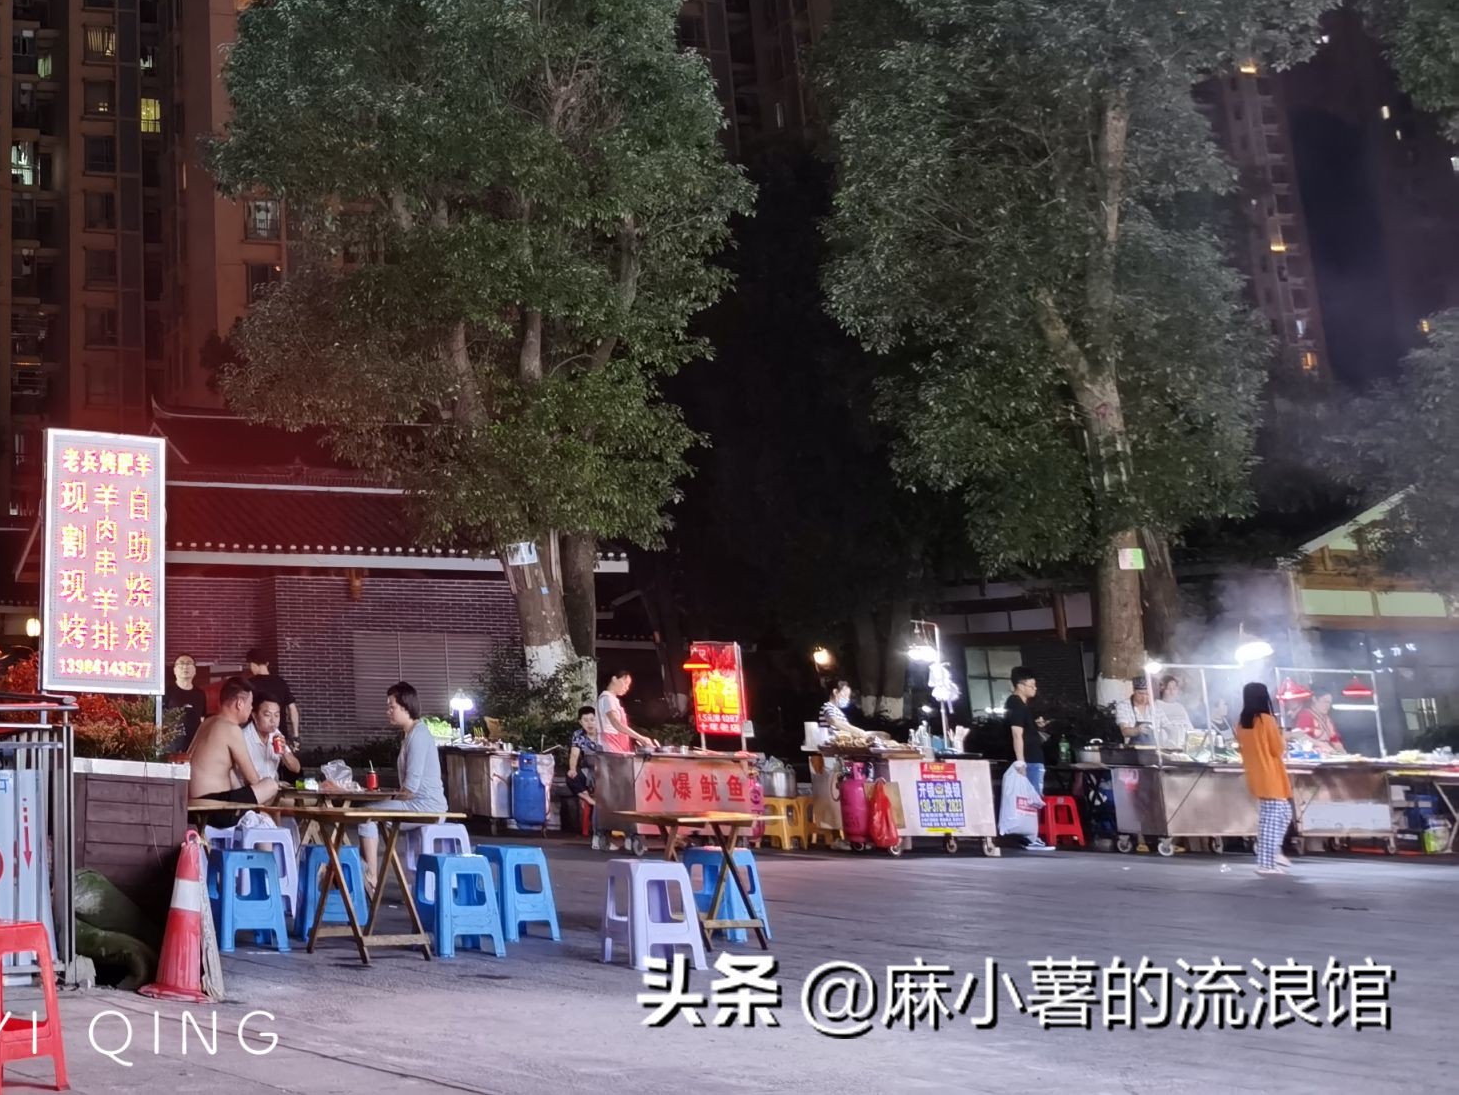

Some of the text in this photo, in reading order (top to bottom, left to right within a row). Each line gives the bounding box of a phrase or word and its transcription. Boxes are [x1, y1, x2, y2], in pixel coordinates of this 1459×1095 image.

[62, 447, 153, 478] 老兵烤肥羊
[57, 480, 89, 649] 现割现烤
[124, 484, 153, 653] 自助烧烤
[645, 772, 746, 803] 火爆鱿鱼
